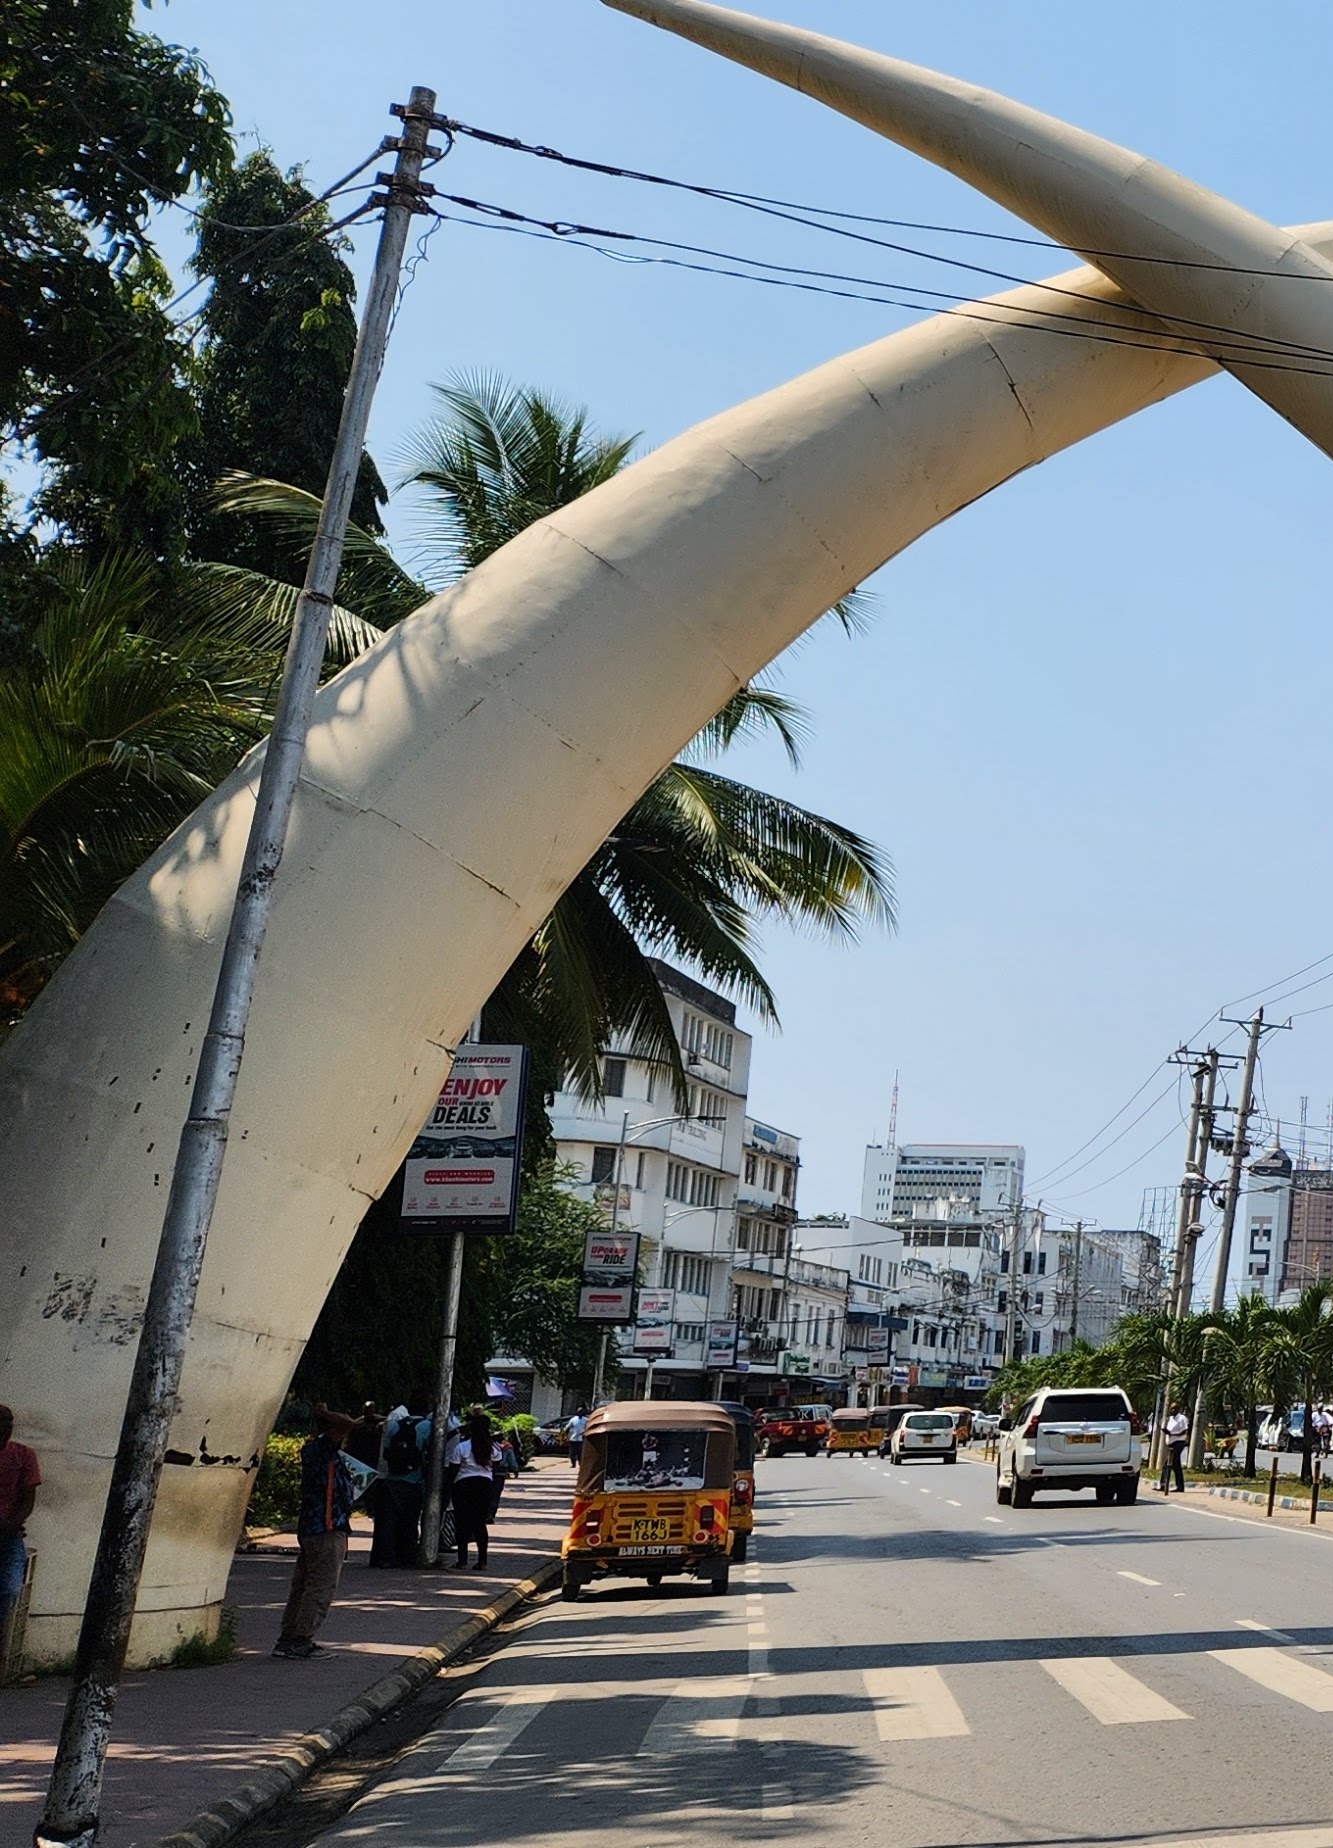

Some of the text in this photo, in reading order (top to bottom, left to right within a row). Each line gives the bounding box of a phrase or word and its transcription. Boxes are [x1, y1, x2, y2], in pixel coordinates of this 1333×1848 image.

[439, 1079, 507, 1099] ENJOY
[438, 1098, 459, 1106] OUR
[432, 1106, 491, 1124] DEALS
[602, 1254, 626, 1265] RIDE
[634, 1519, 667, 1530] KTWB
[635, 1530, 667, 1540] 166J
[618, 1546, 645, 1556] ALWAYS
